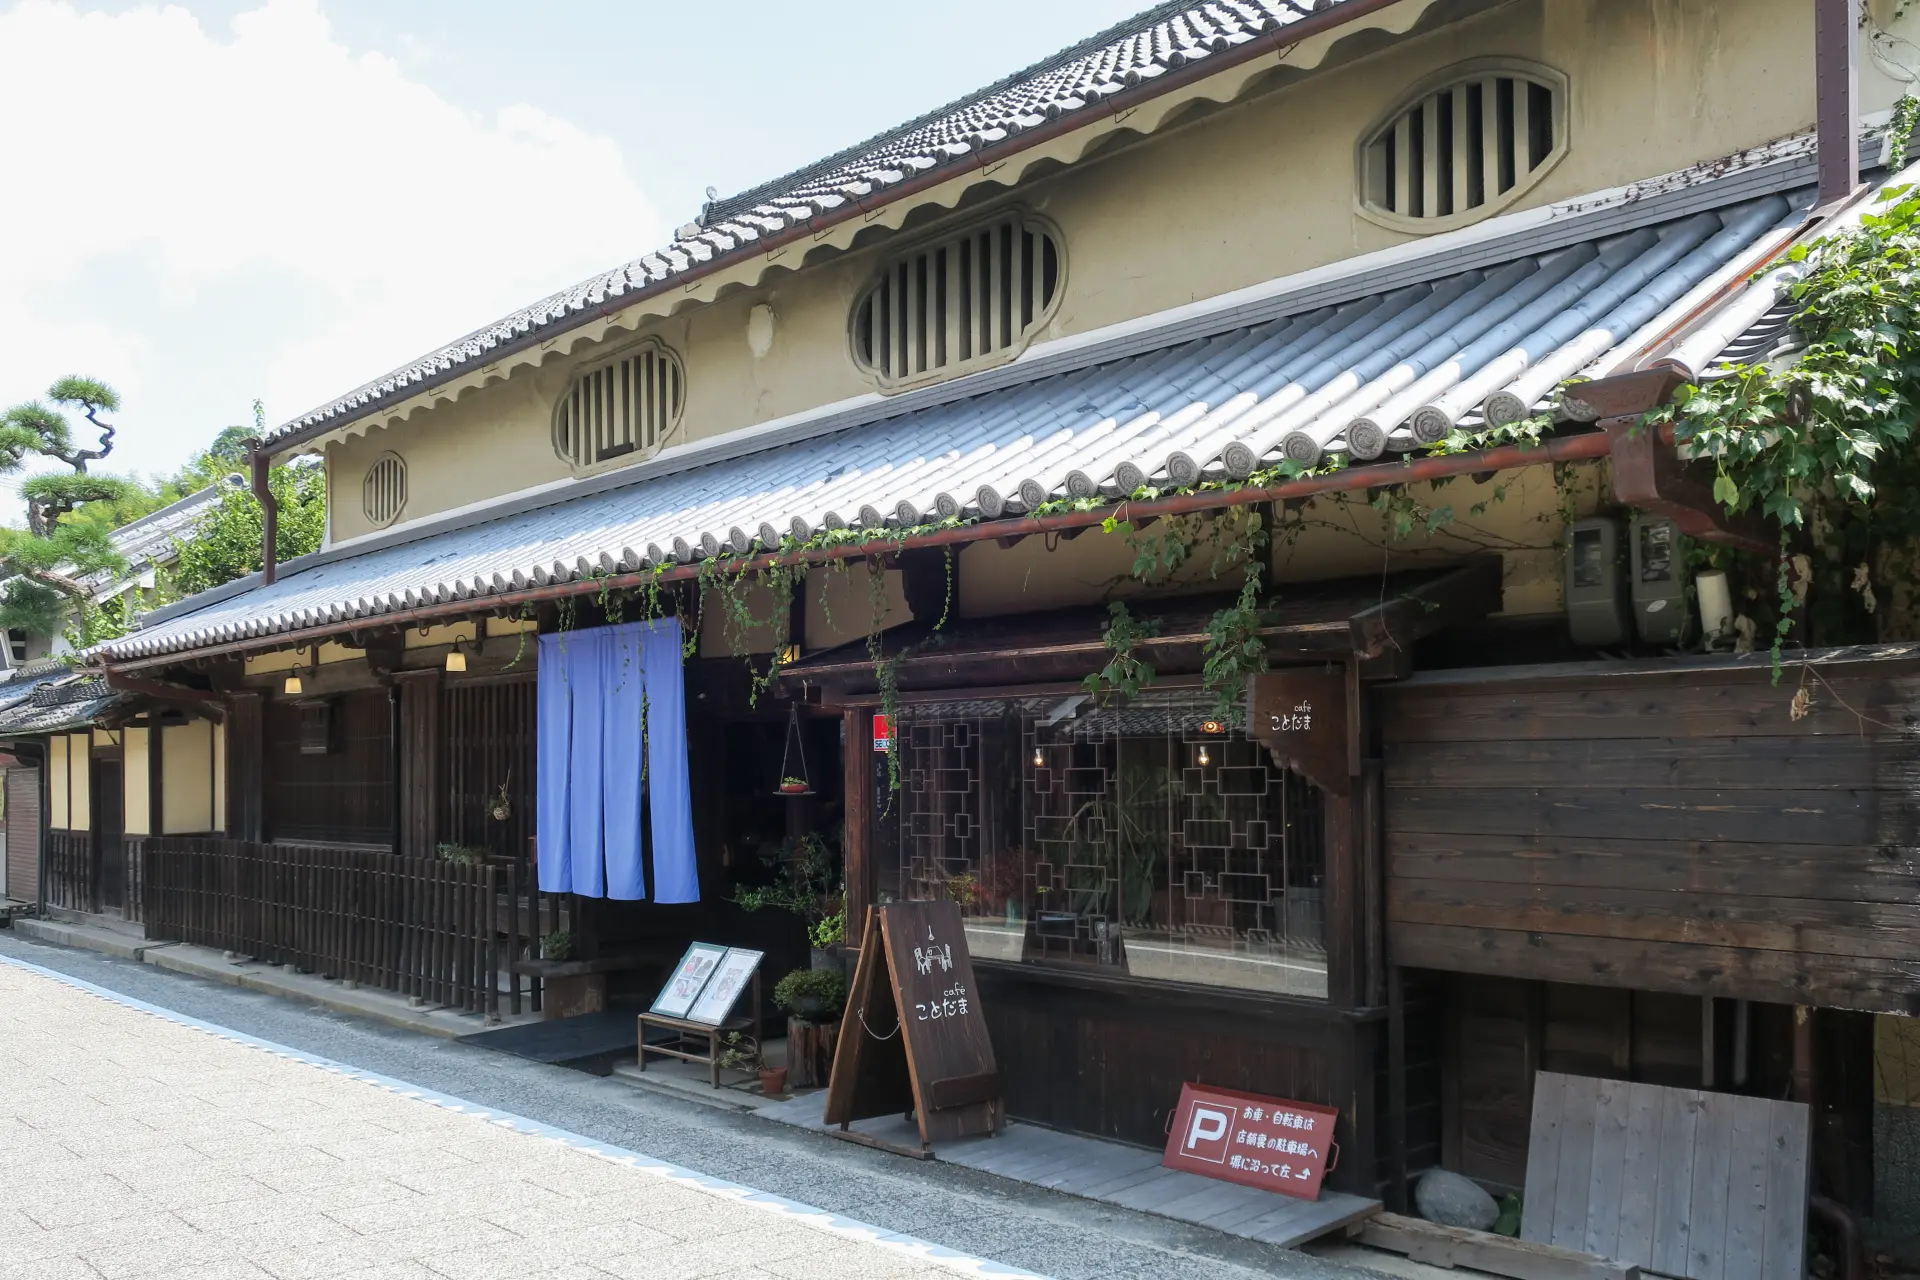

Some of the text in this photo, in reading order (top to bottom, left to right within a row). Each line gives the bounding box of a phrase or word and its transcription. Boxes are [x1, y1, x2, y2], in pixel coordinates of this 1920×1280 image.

[1271, 713, 1312, 731] ことだま
[943, 981, 966, 997] café
[915, 998, 969, 1021] ことだま
[1187, 1108, 1228, 1150] P
[1236, 1129, 1318, 1159] 店舗裏の駐車場へ
